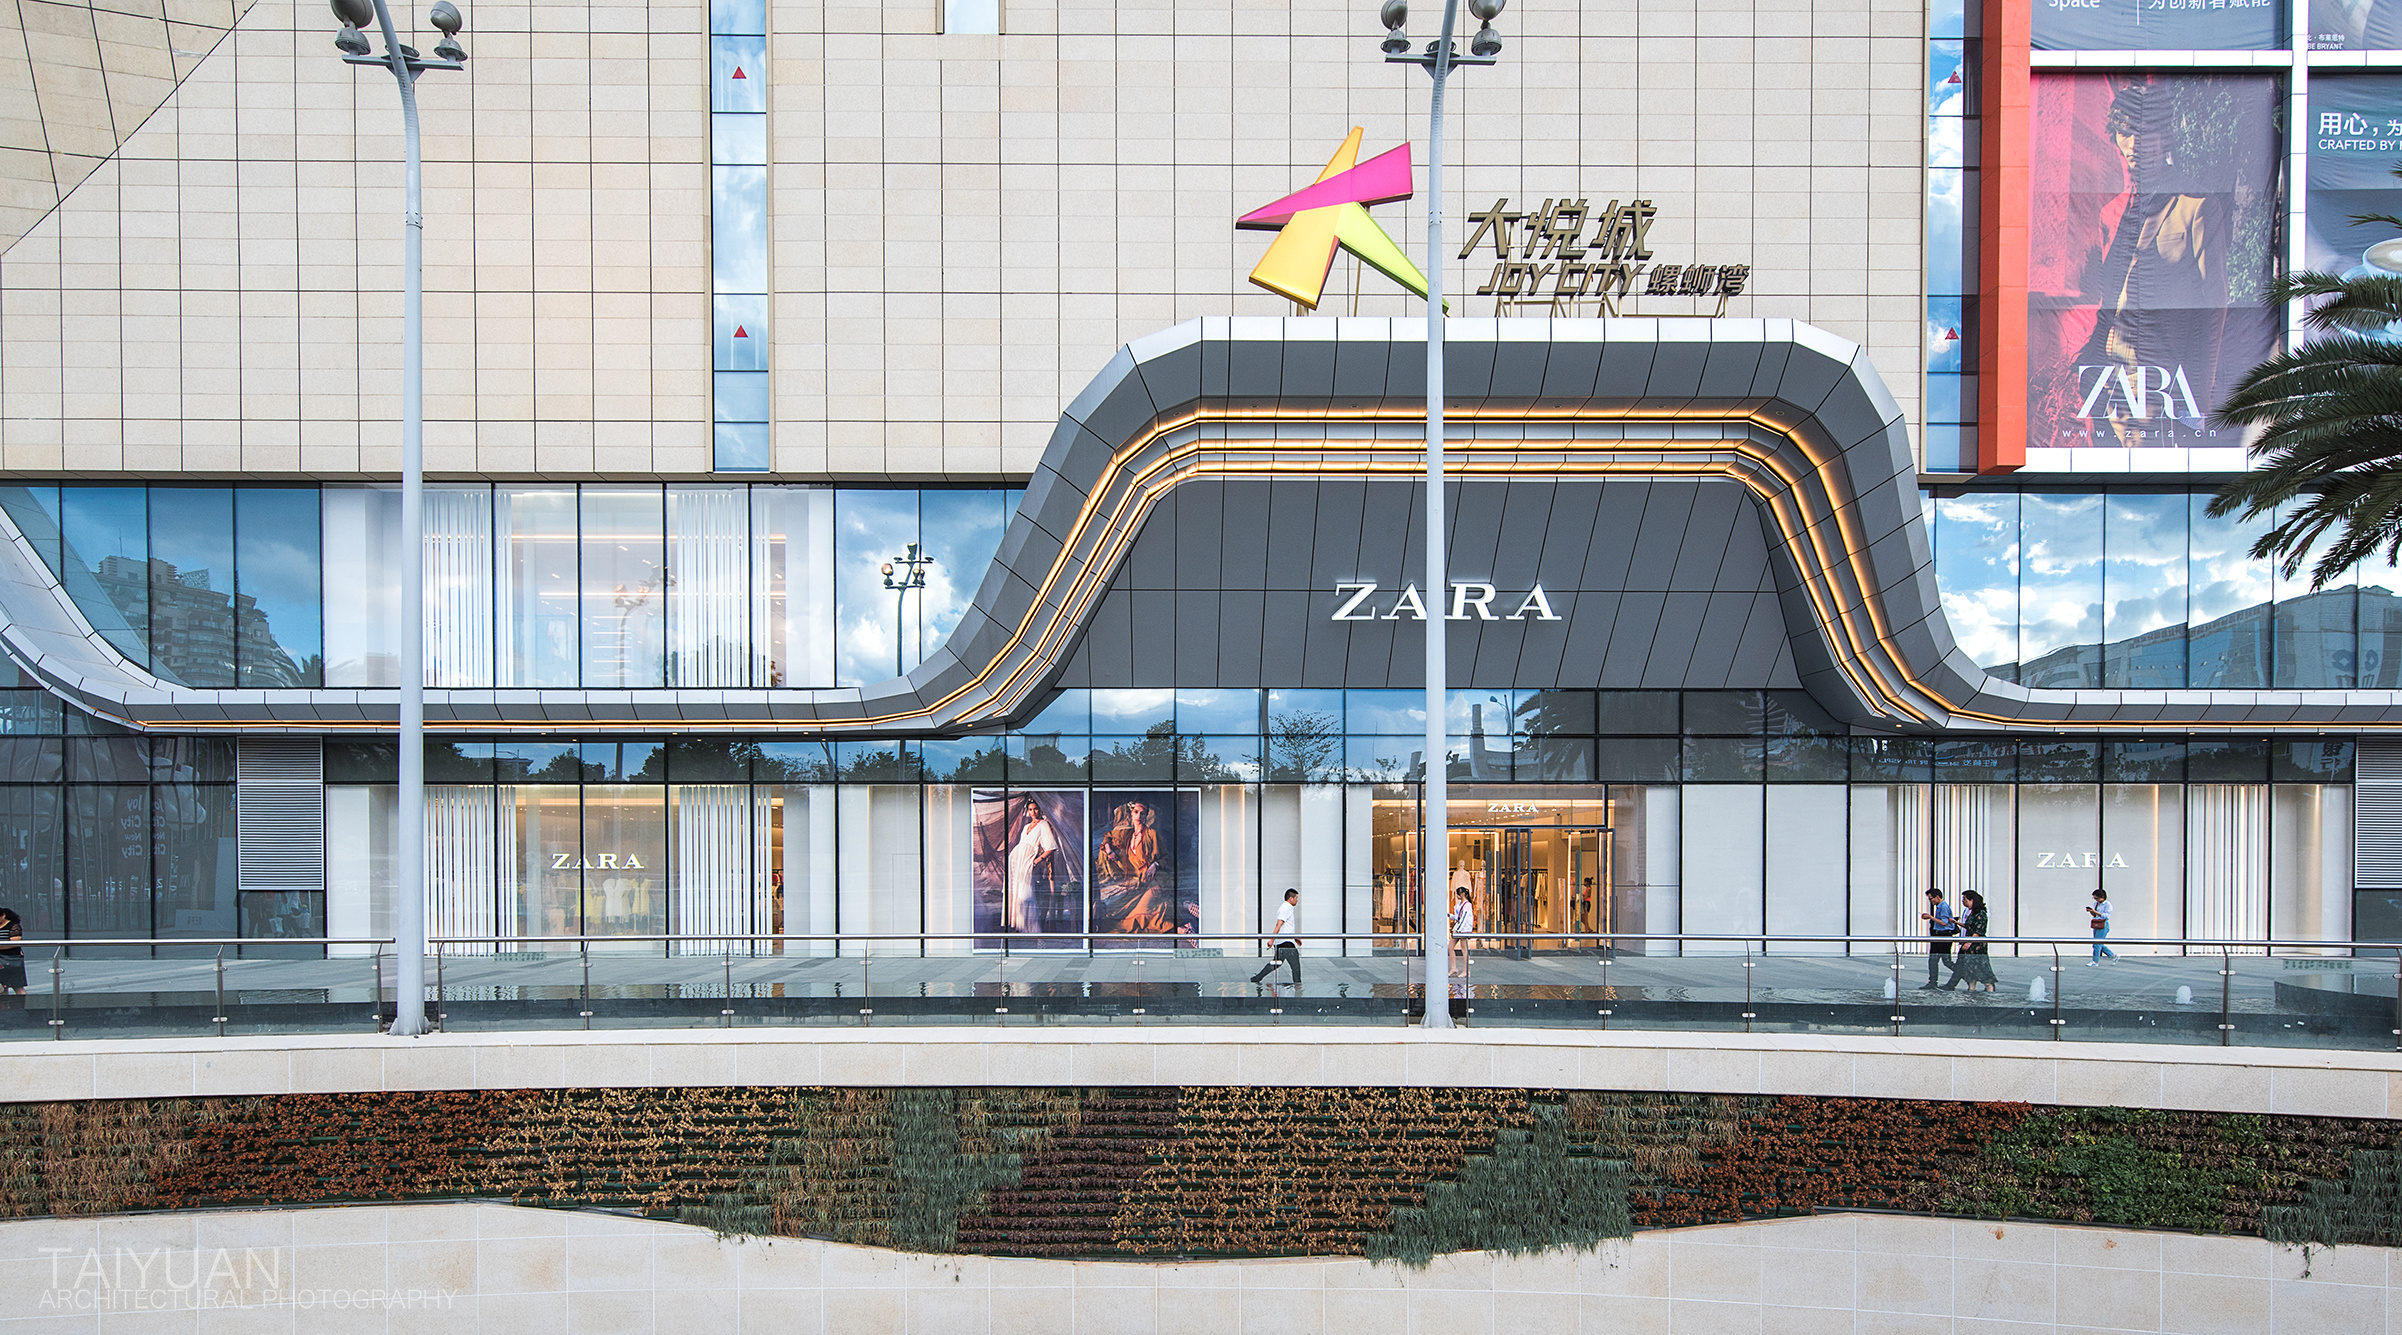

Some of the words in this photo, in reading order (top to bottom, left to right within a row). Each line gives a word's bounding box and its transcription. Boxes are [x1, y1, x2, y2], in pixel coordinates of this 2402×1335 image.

[2318, 139, 2376, 150] CRAFTED
[2380, 140, 2396, 150] BY
[1458, 198, 1657, 260] 大悦城
[1476, 263, 1555, 296] JOY
[1554, 263, 1644, 296] CITY
[2076, 364, 2208, 420] ZARA
[2062, 429, 2217, 438] www.zara.cn
[1331, 582, 1562, 621] ZARA
[1488, 803, 1539, 813] ZARA
[551, 853, 645, 870] ZARA
[2036, 852, 2129, 868] ZARA
